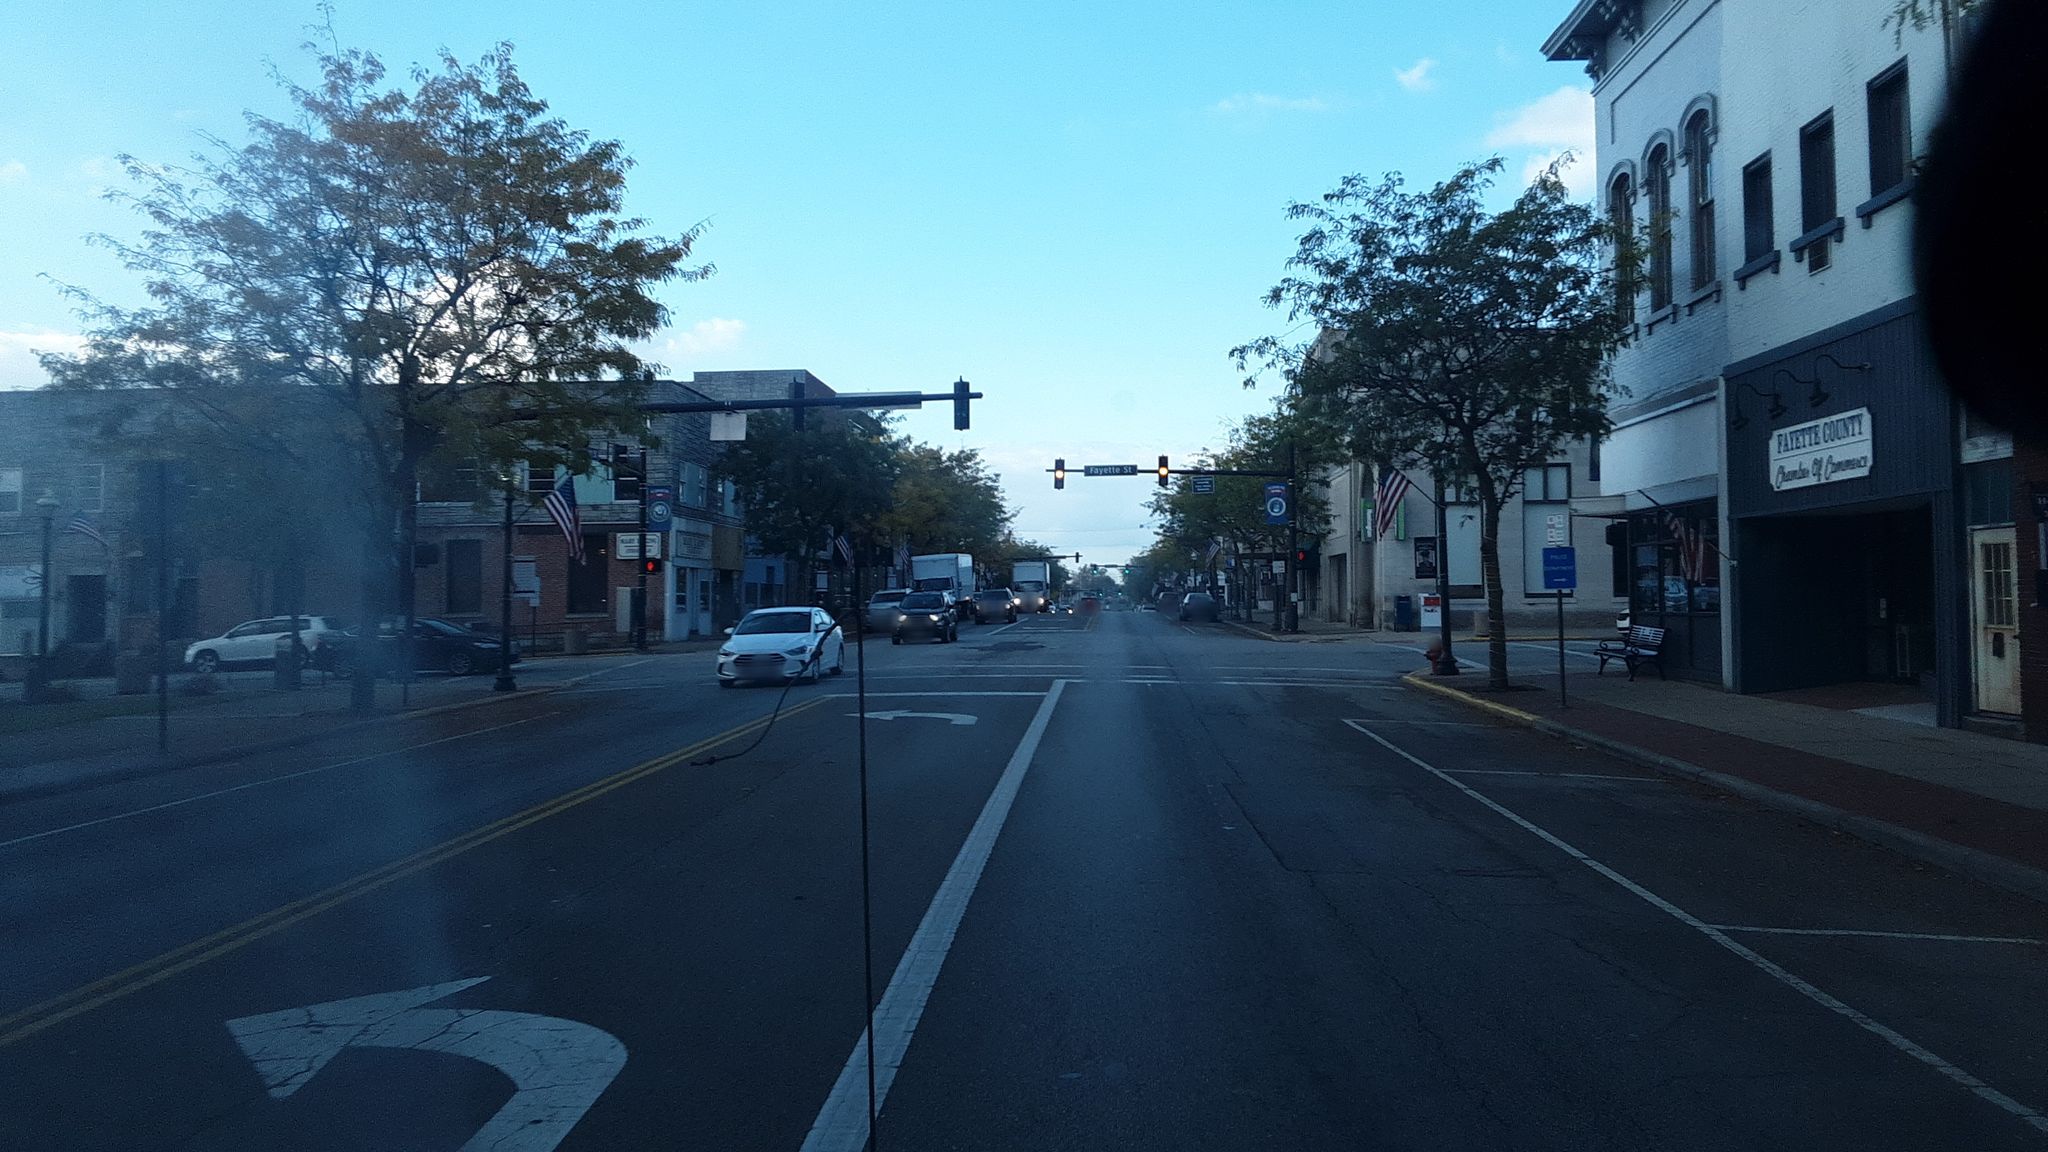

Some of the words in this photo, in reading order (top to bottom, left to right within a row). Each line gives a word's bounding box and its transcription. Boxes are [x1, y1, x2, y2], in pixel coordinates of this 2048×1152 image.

[1777, 424, 1820, 454] FAYETTE
[1823, 413, 1863, 443] COUNTY
[1090, 466, 1121, 475] Fayette
[1123, 465, 1133, 474] St
